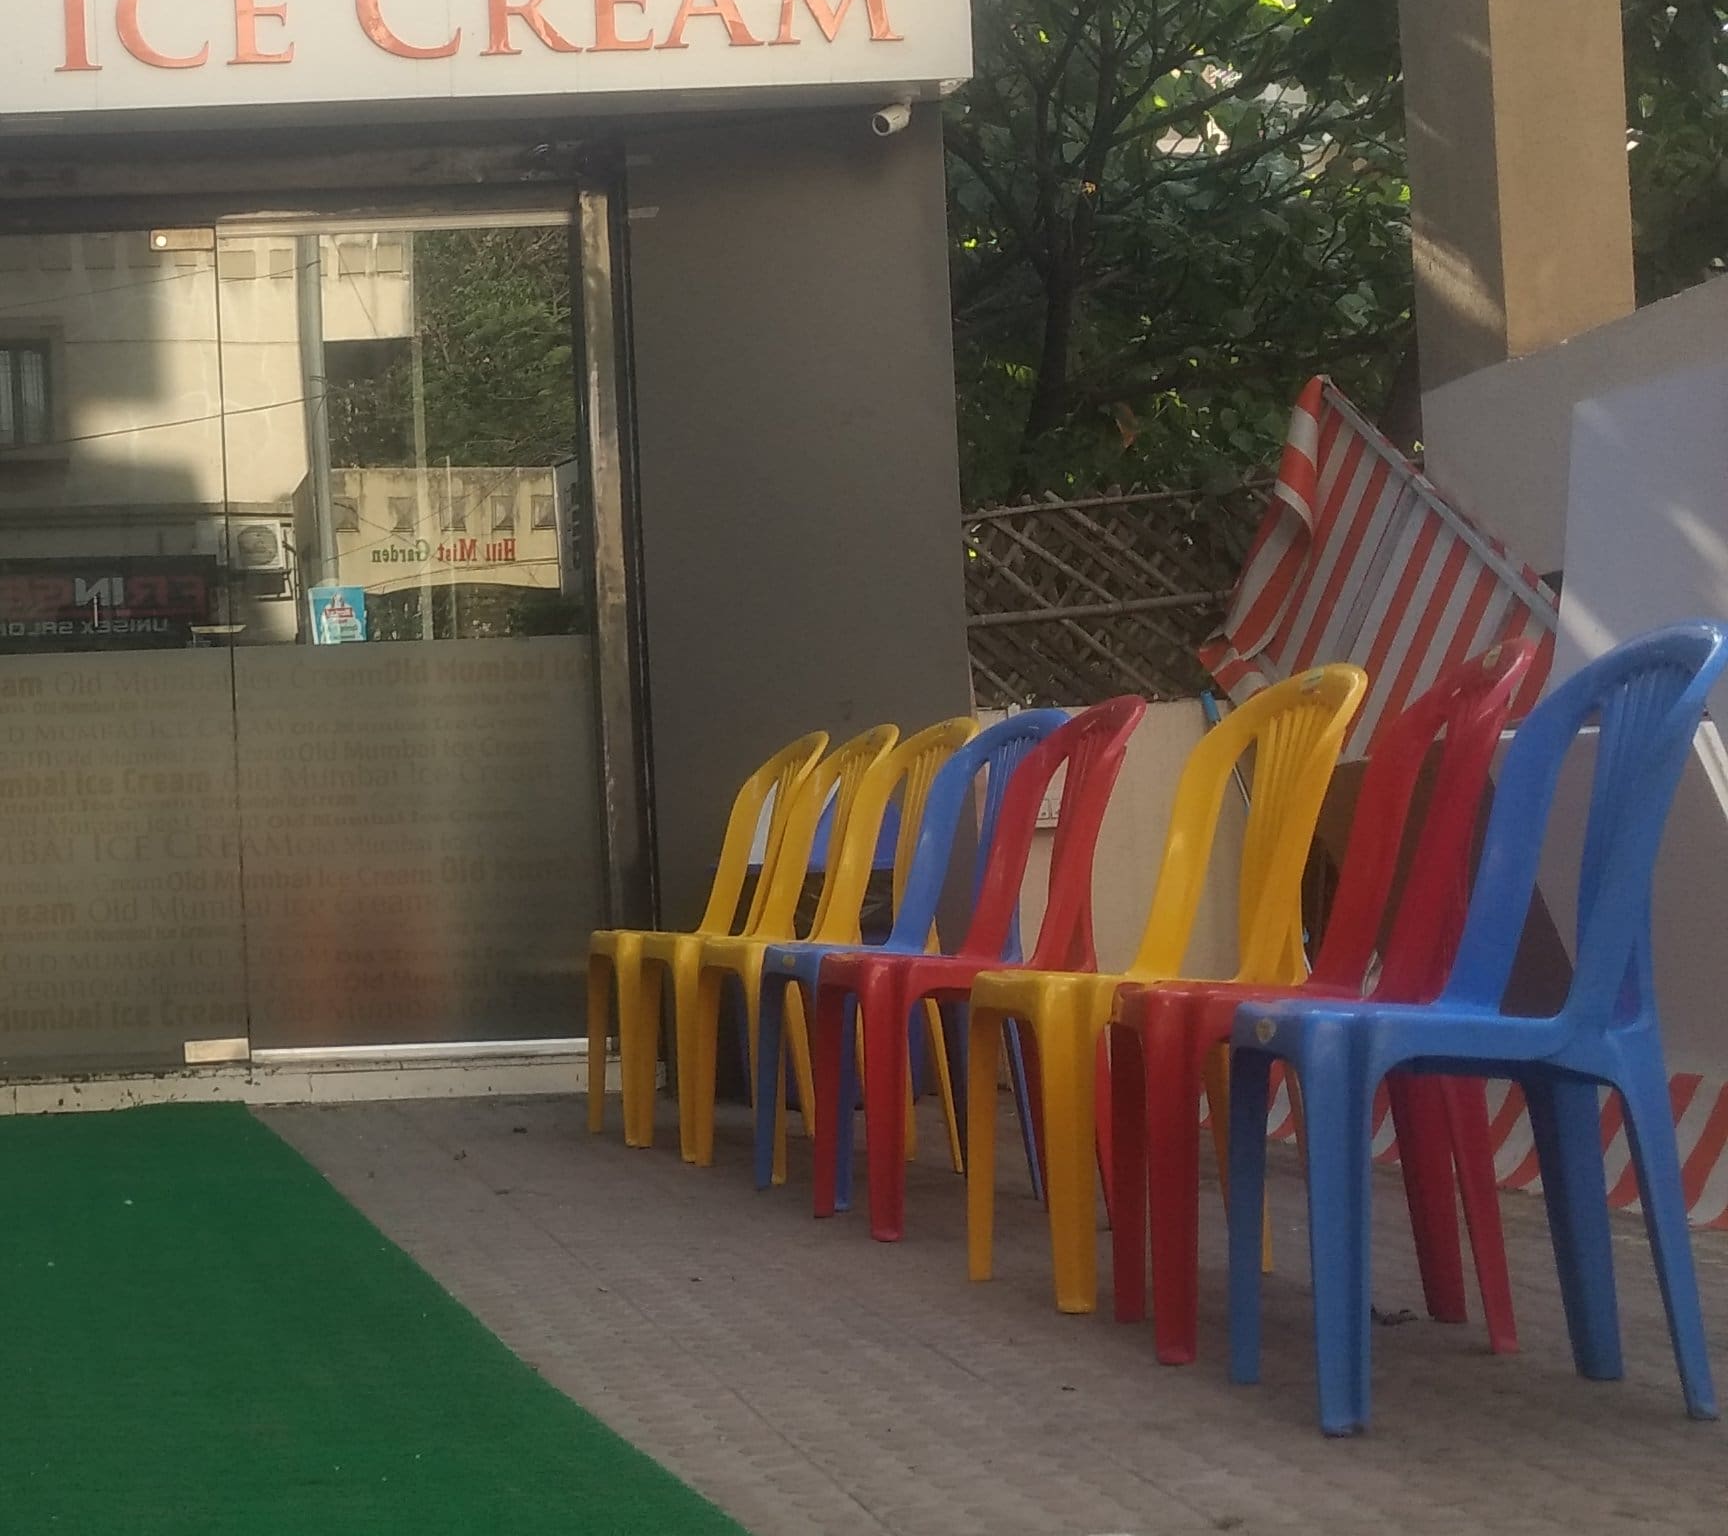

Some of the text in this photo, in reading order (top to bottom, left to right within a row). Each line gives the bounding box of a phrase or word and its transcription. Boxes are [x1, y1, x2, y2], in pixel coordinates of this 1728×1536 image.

[75, 770, 114, 796] Ice
[122, 767, 212, 794] Cream
[94, 833, 153, 863] ICE
[111, 1000, 152, 1028] Ice
